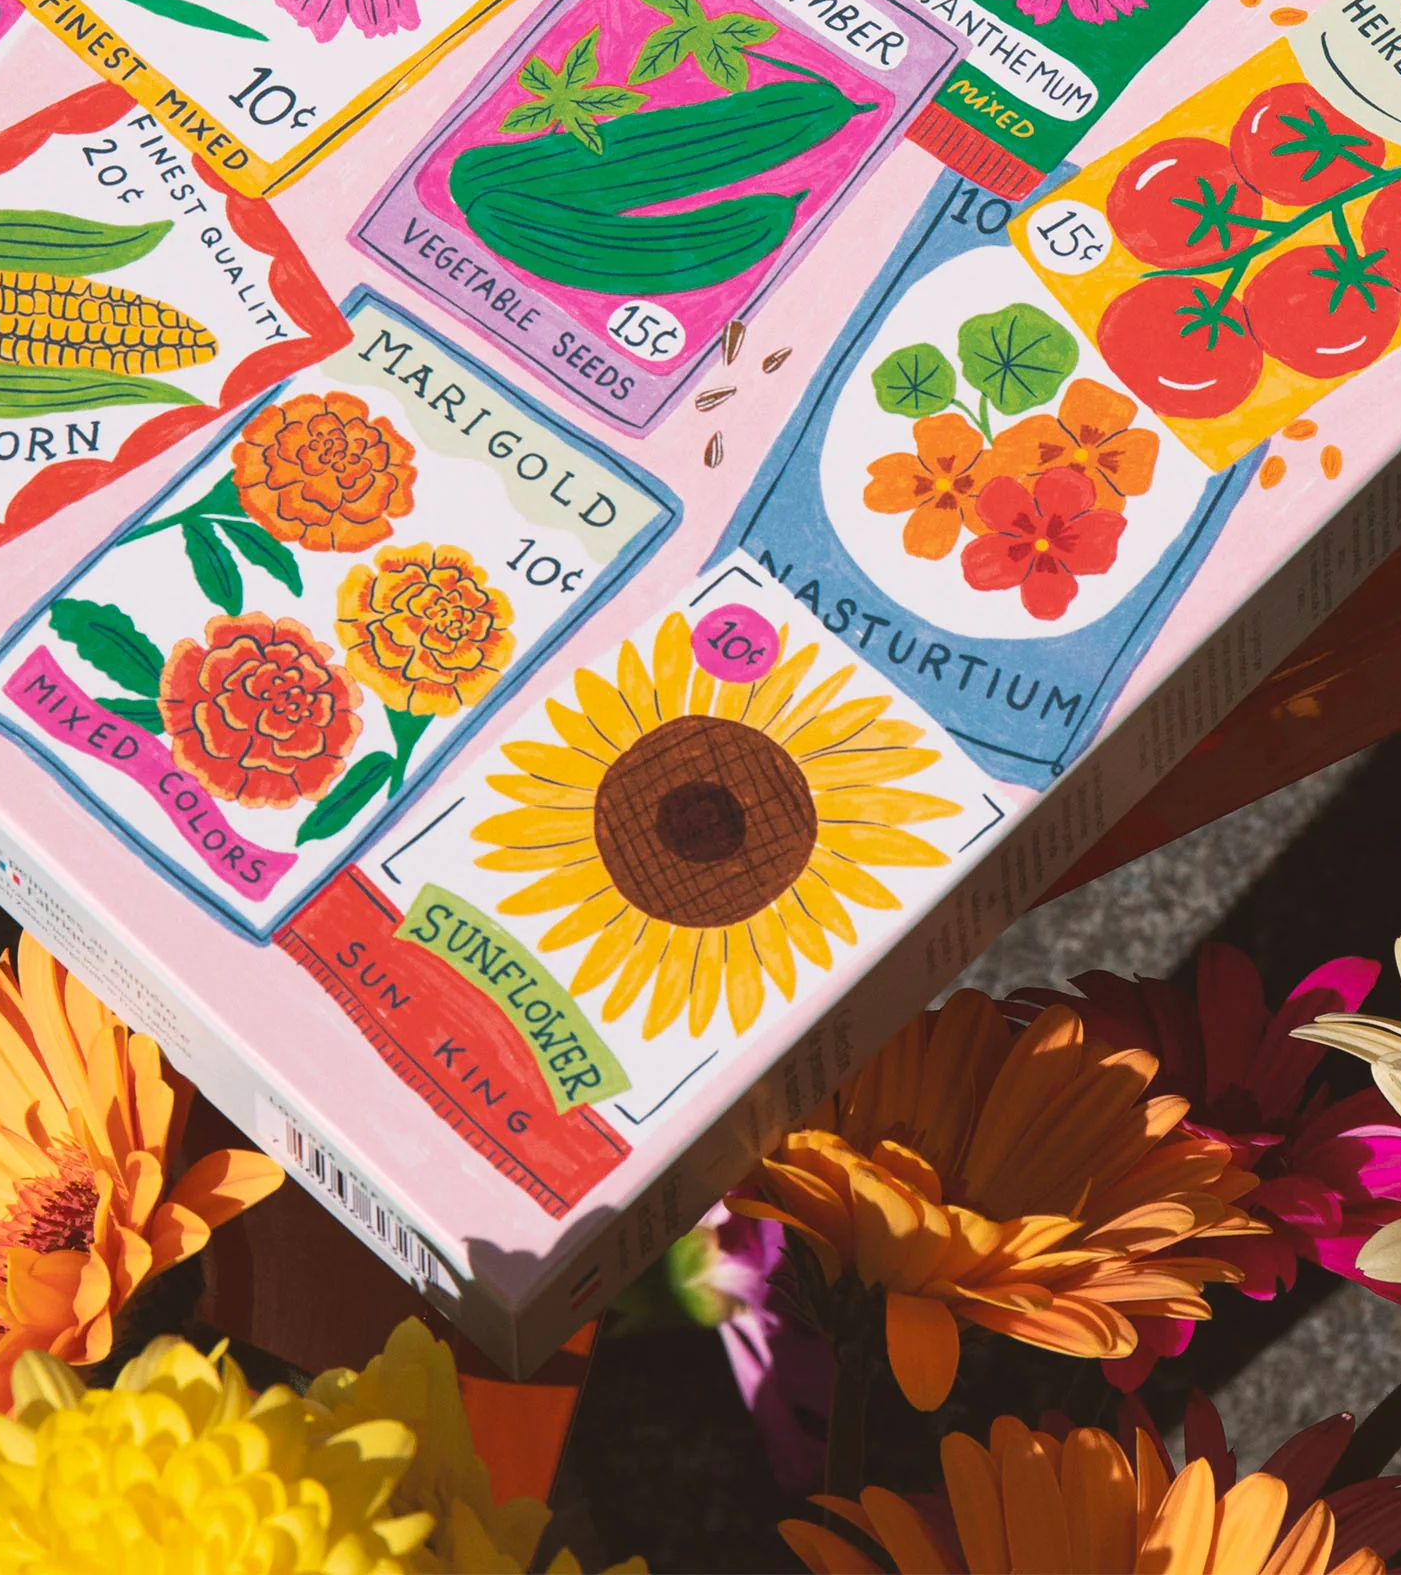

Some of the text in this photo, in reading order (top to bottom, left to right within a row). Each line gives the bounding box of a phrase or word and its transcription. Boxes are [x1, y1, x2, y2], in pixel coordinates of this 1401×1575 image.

[158, 89, 251, 174] MIXED
[228, 67, 316, 129] 10¢
[81, 139, 145, 205] 20¢
[128, 115, 289, 343] FINEST QUALITY
[1034, 210, 1107, 265] 15¢
[401, 217, 637, 402] VEGETABLE SEEDS
[608, 306, 681, 357] 15¢
[358, 329, 618, 529] MARIGOLD
[504, 537, 585, 595] 10¢
[706, 620, 766, 667] 10¢
[758, 551, 1083, 728] NASTURTIUM
[23, 673, 268, 886] MIXED COLORS
[335, 941, 531, 1137] SUN KING
[410, 903, 602, 1101] SUNFLOWER
